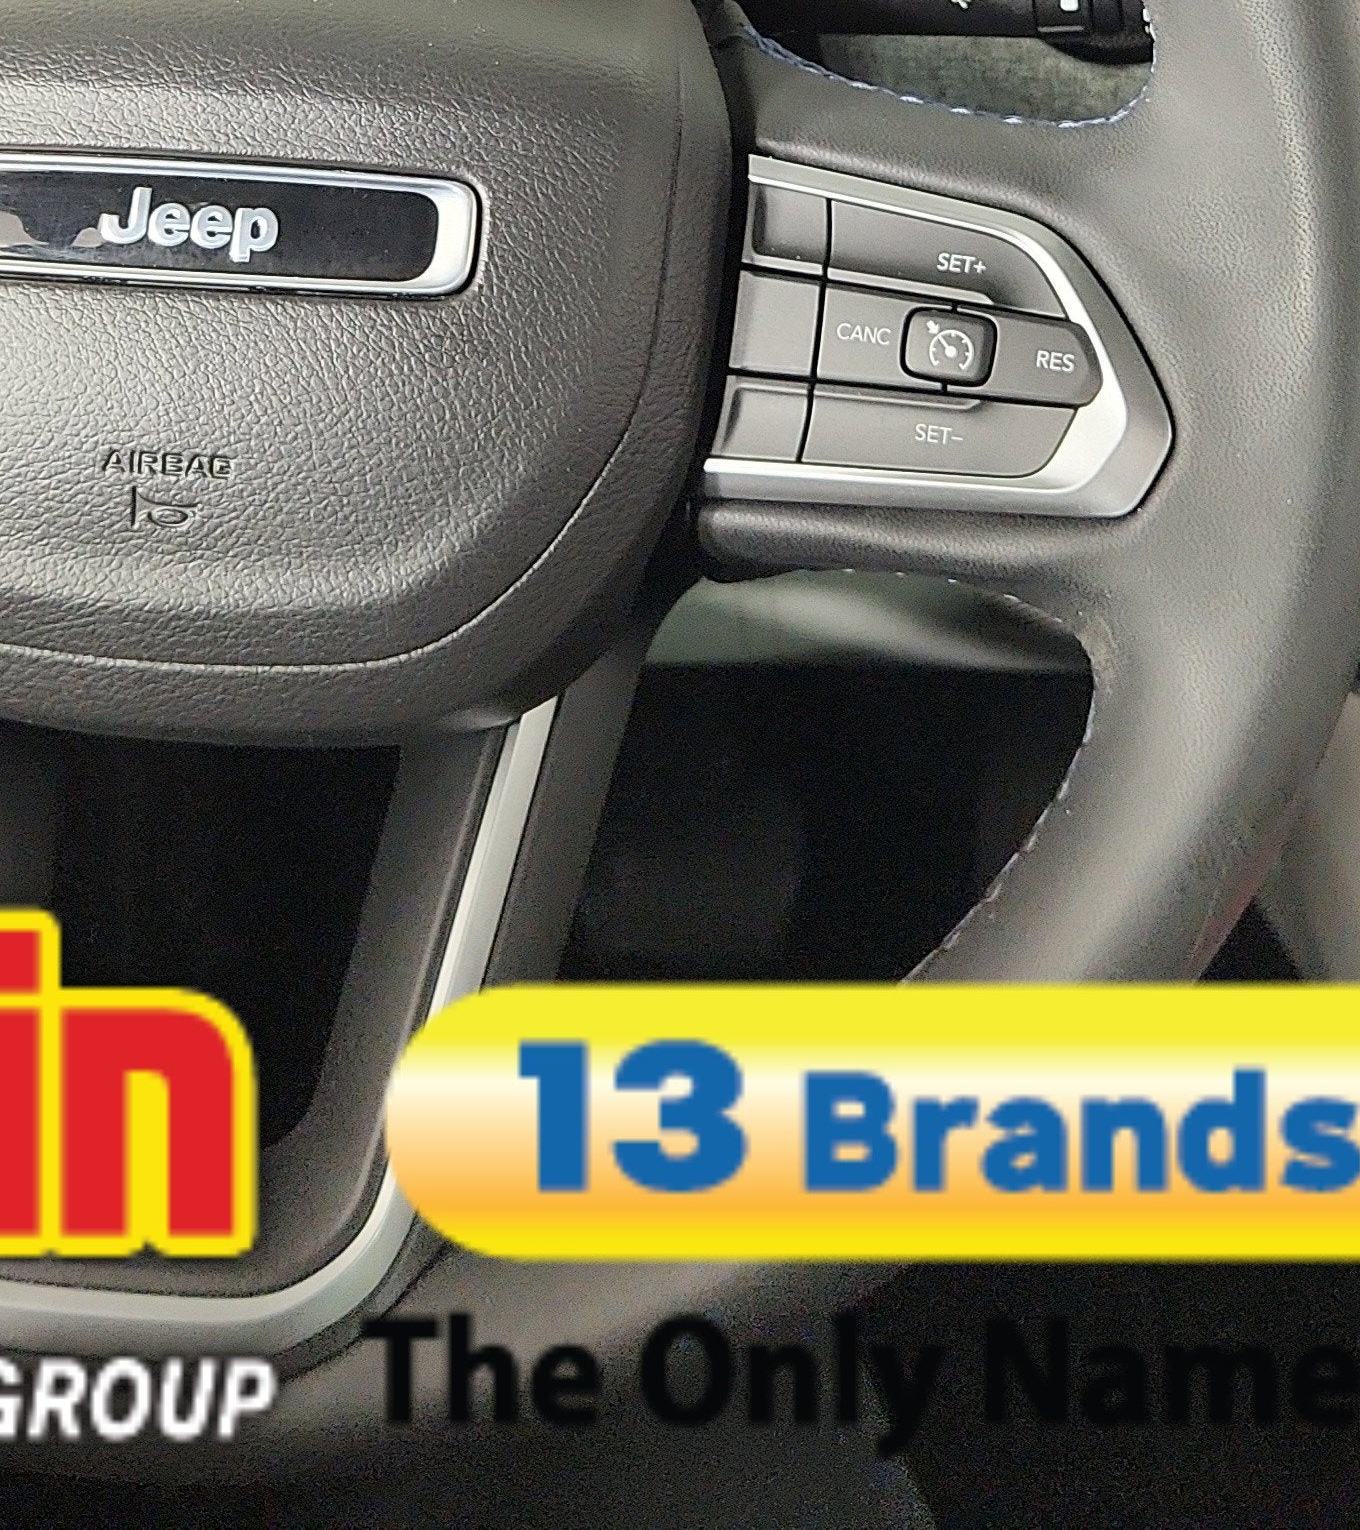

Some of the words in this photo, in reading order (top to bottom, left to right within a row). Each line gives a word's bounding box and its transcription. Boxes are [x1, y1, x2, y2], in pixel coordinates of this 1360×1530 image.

[100, 187, 279, 262] Jeep
[936, 251, 987, 276] SET+
[836, 321, 891, 347] CANC
[1035, 349, 1076, 373] RES
[102, 449, 232, 480] AIRBAG
